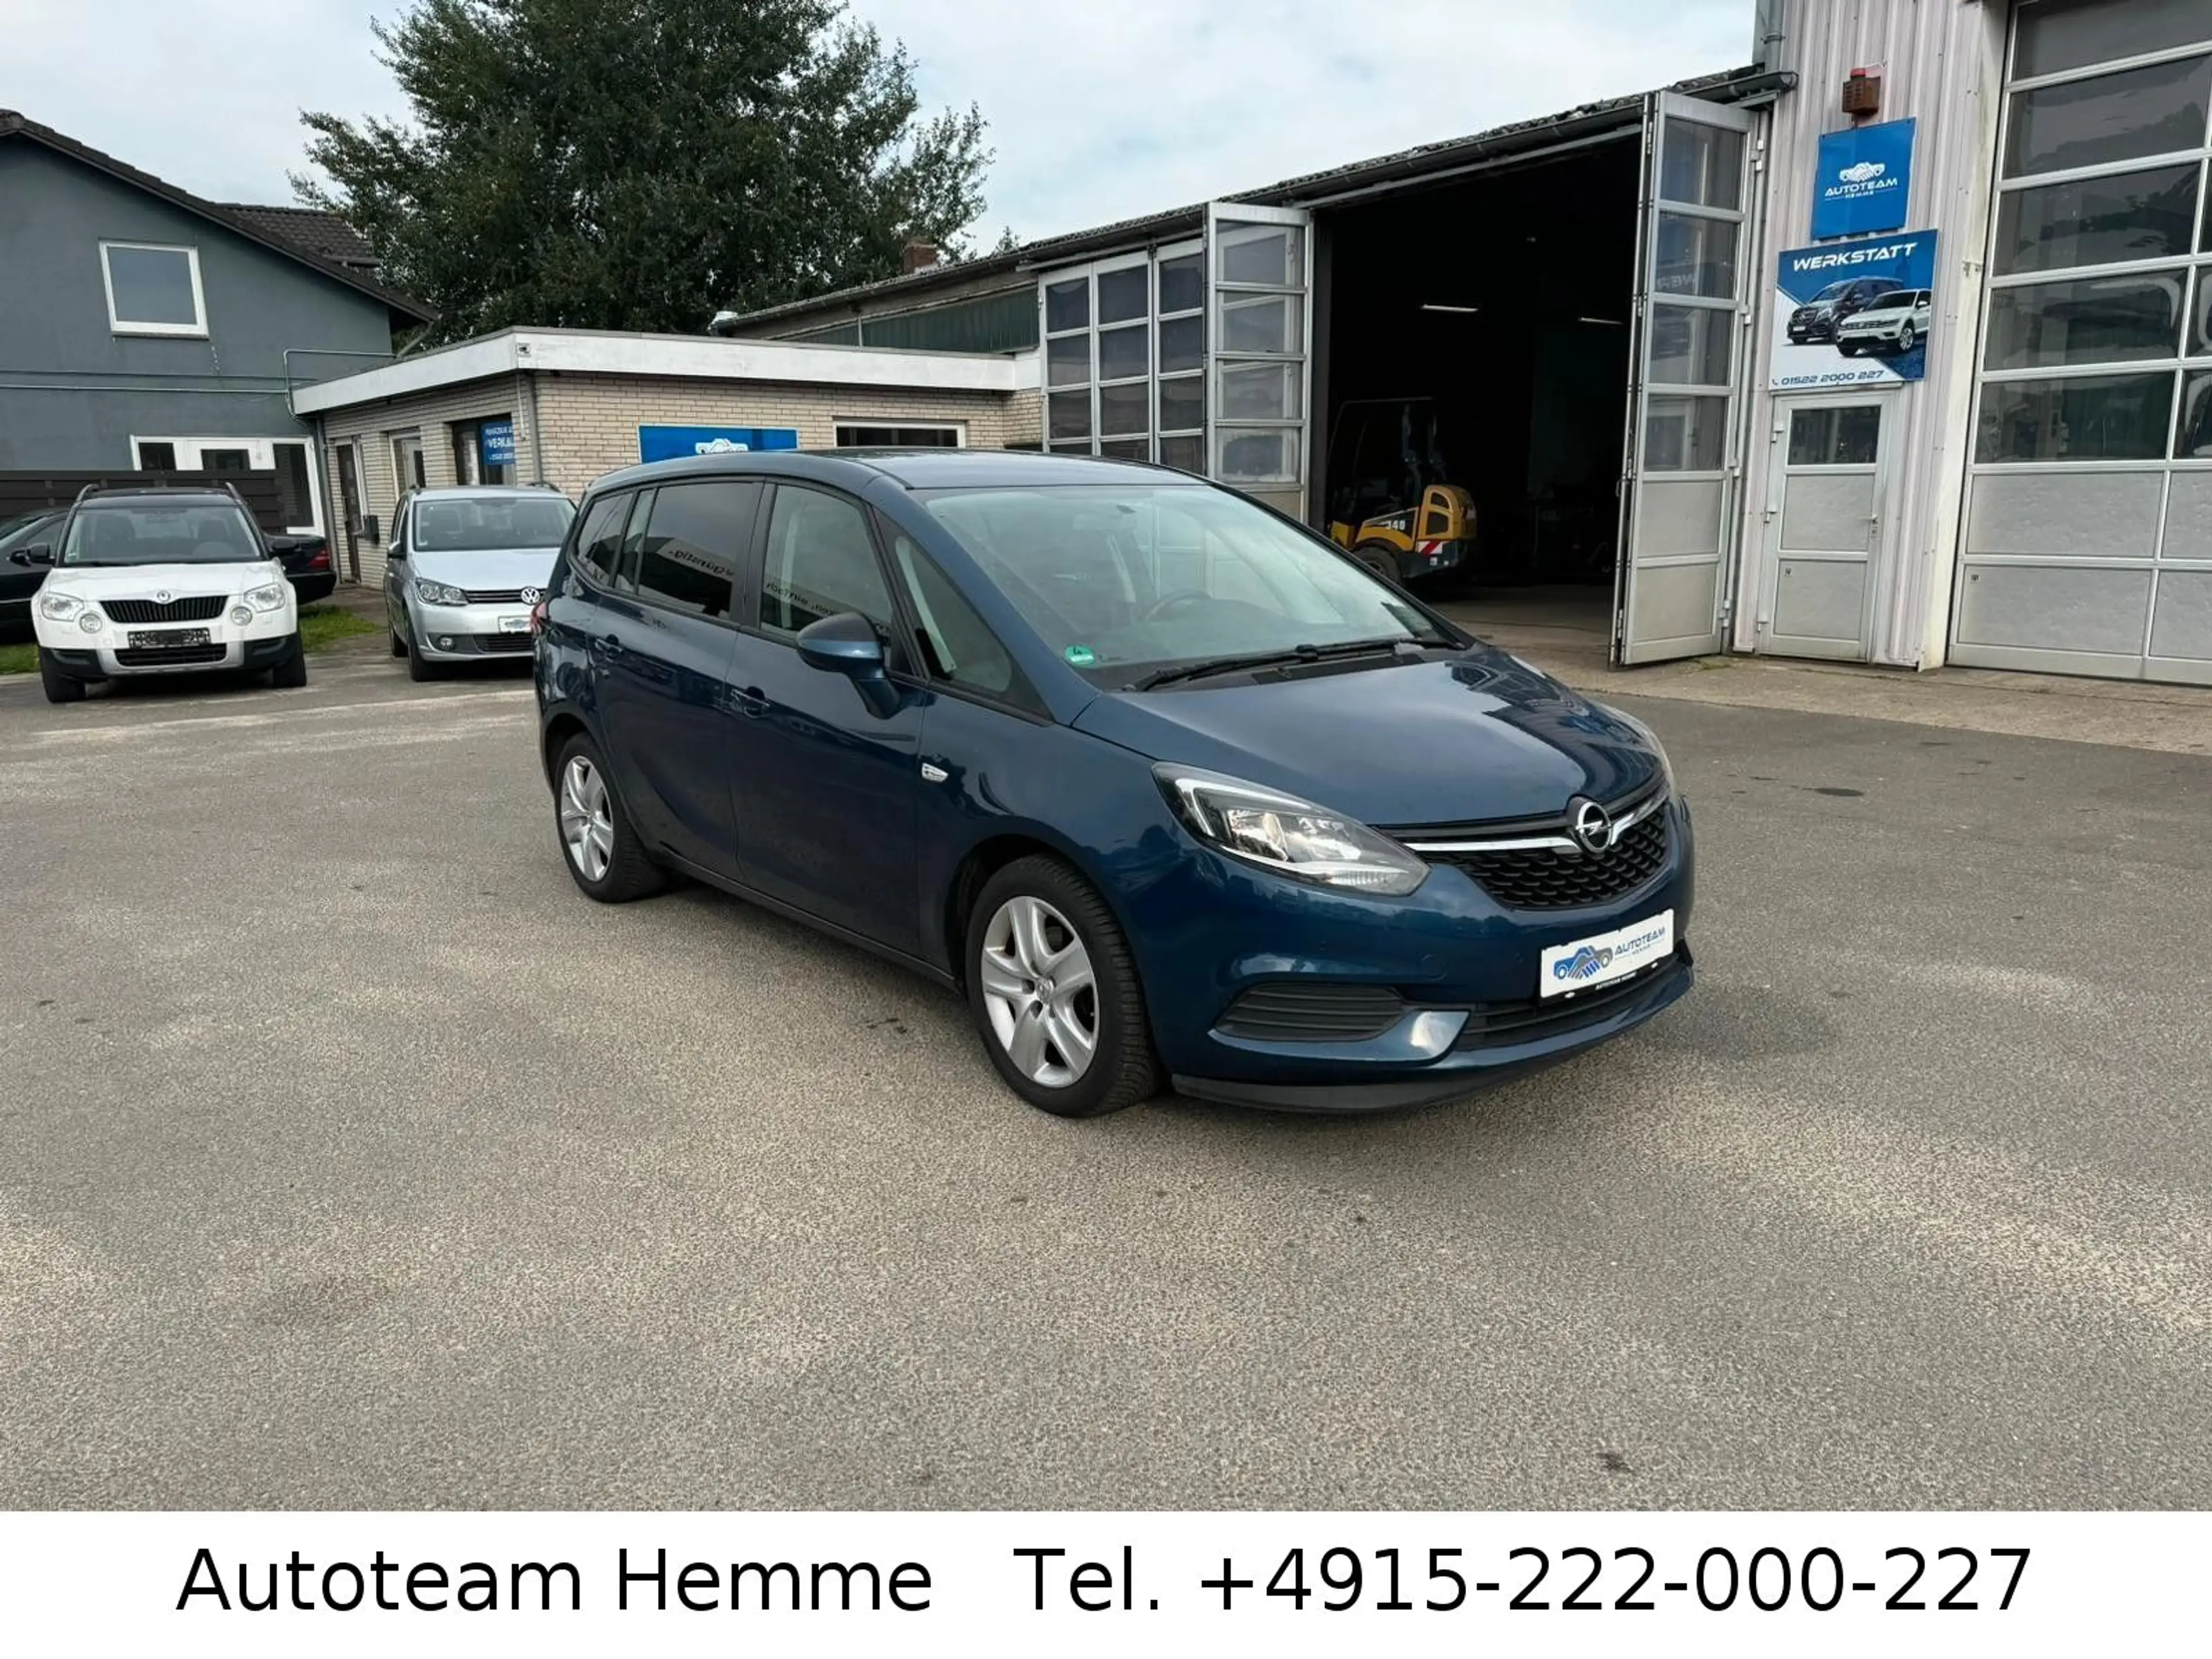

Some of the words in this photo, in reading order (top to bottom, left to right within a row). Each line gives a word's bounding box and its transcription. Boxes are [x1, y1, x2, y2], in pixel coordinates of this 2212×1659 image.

[1825, 177, 1897, 196] AUTOTEAM
[1793, 242, 1918, 272] WERKSTATT
[1781, 375, 1817, 385] 01522
[1820, 372, 1855, 382] 2000
[1858, 370, 1885, 380] 227
[1615, 926, 1665, 955] AUTOTEAM
